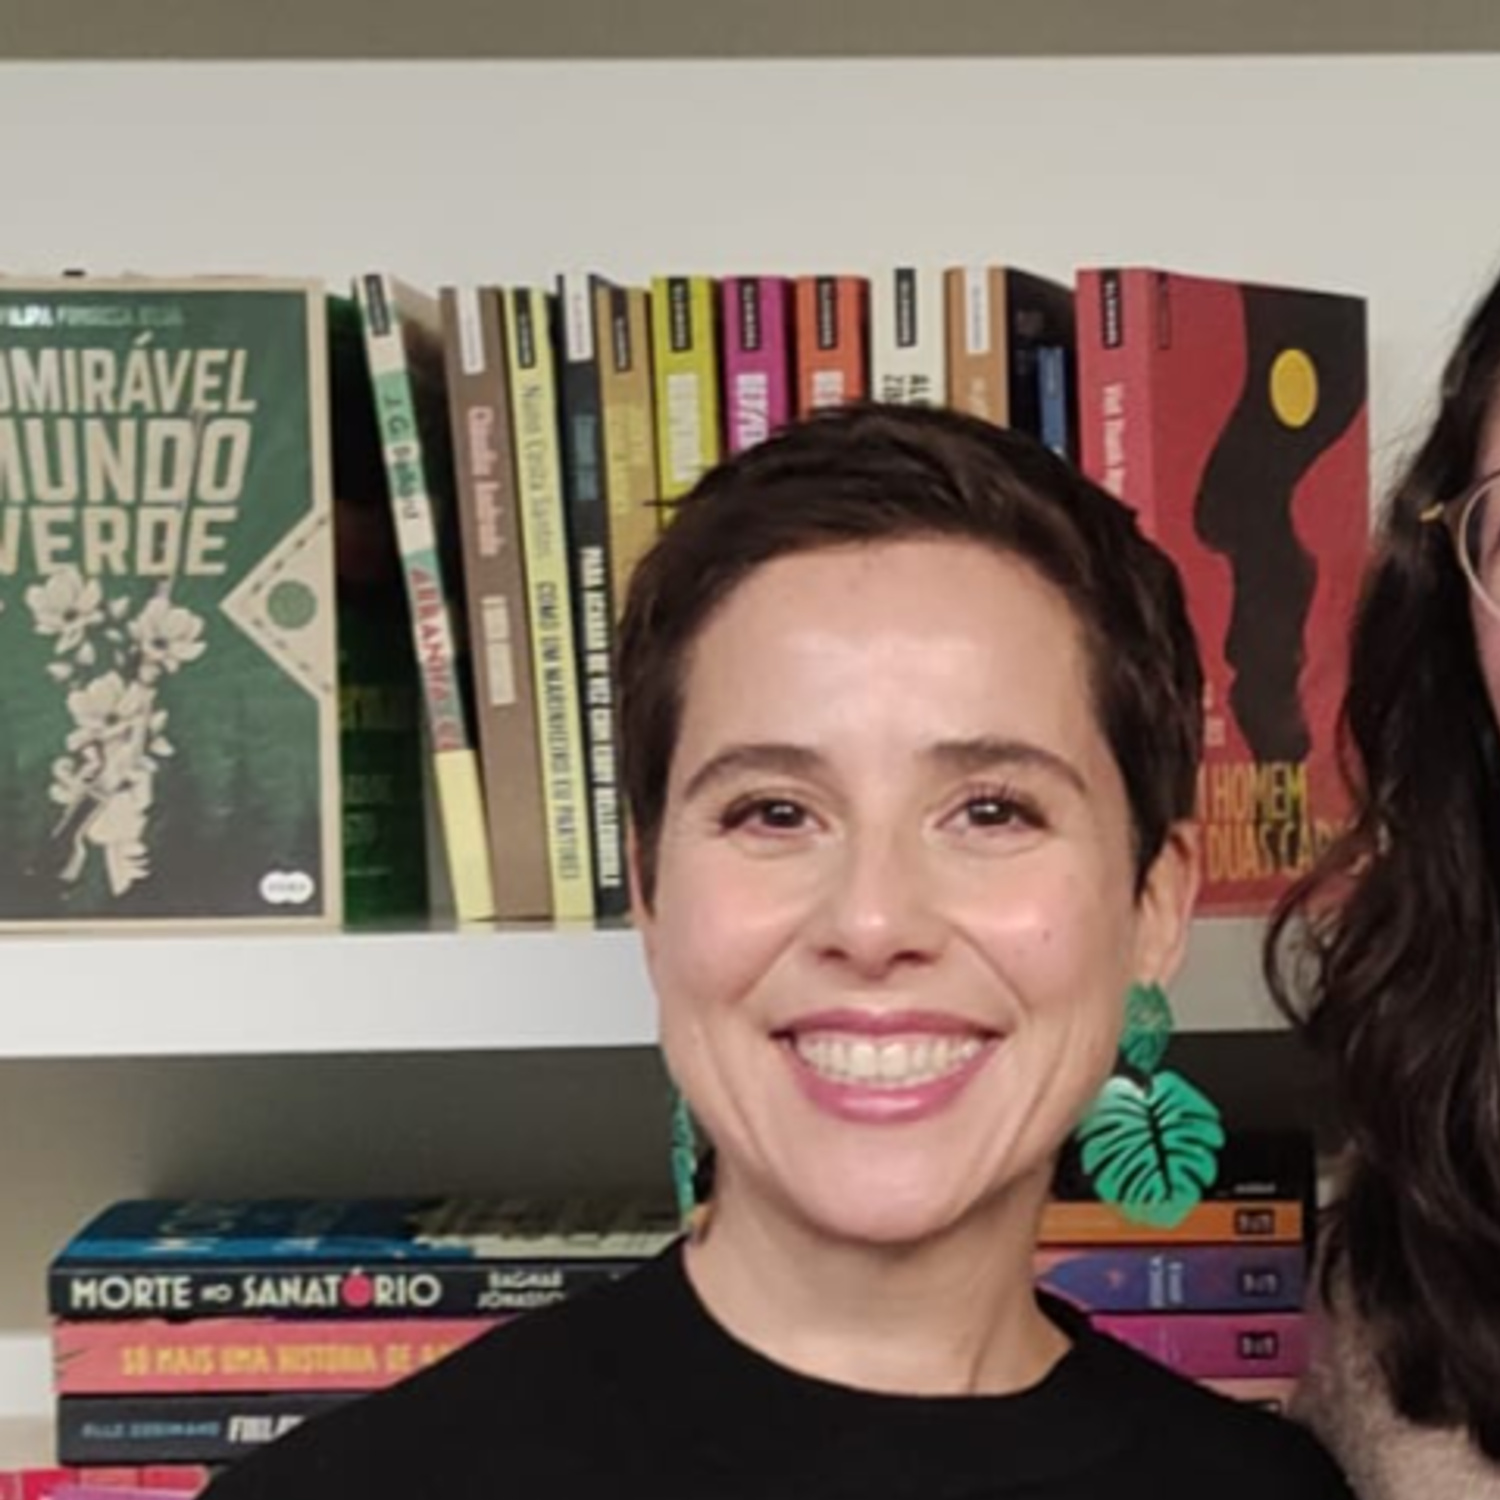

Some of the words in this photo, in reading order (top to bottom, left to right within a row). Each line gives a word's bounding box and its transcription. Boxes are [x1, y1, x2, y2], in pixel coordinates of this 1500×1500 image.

[0, 331, 257, 413] MIRÁVEL
[71, 1274, 192, 1310] MORTE
[242, 1265, 443, 1310] SANATÓRIO
